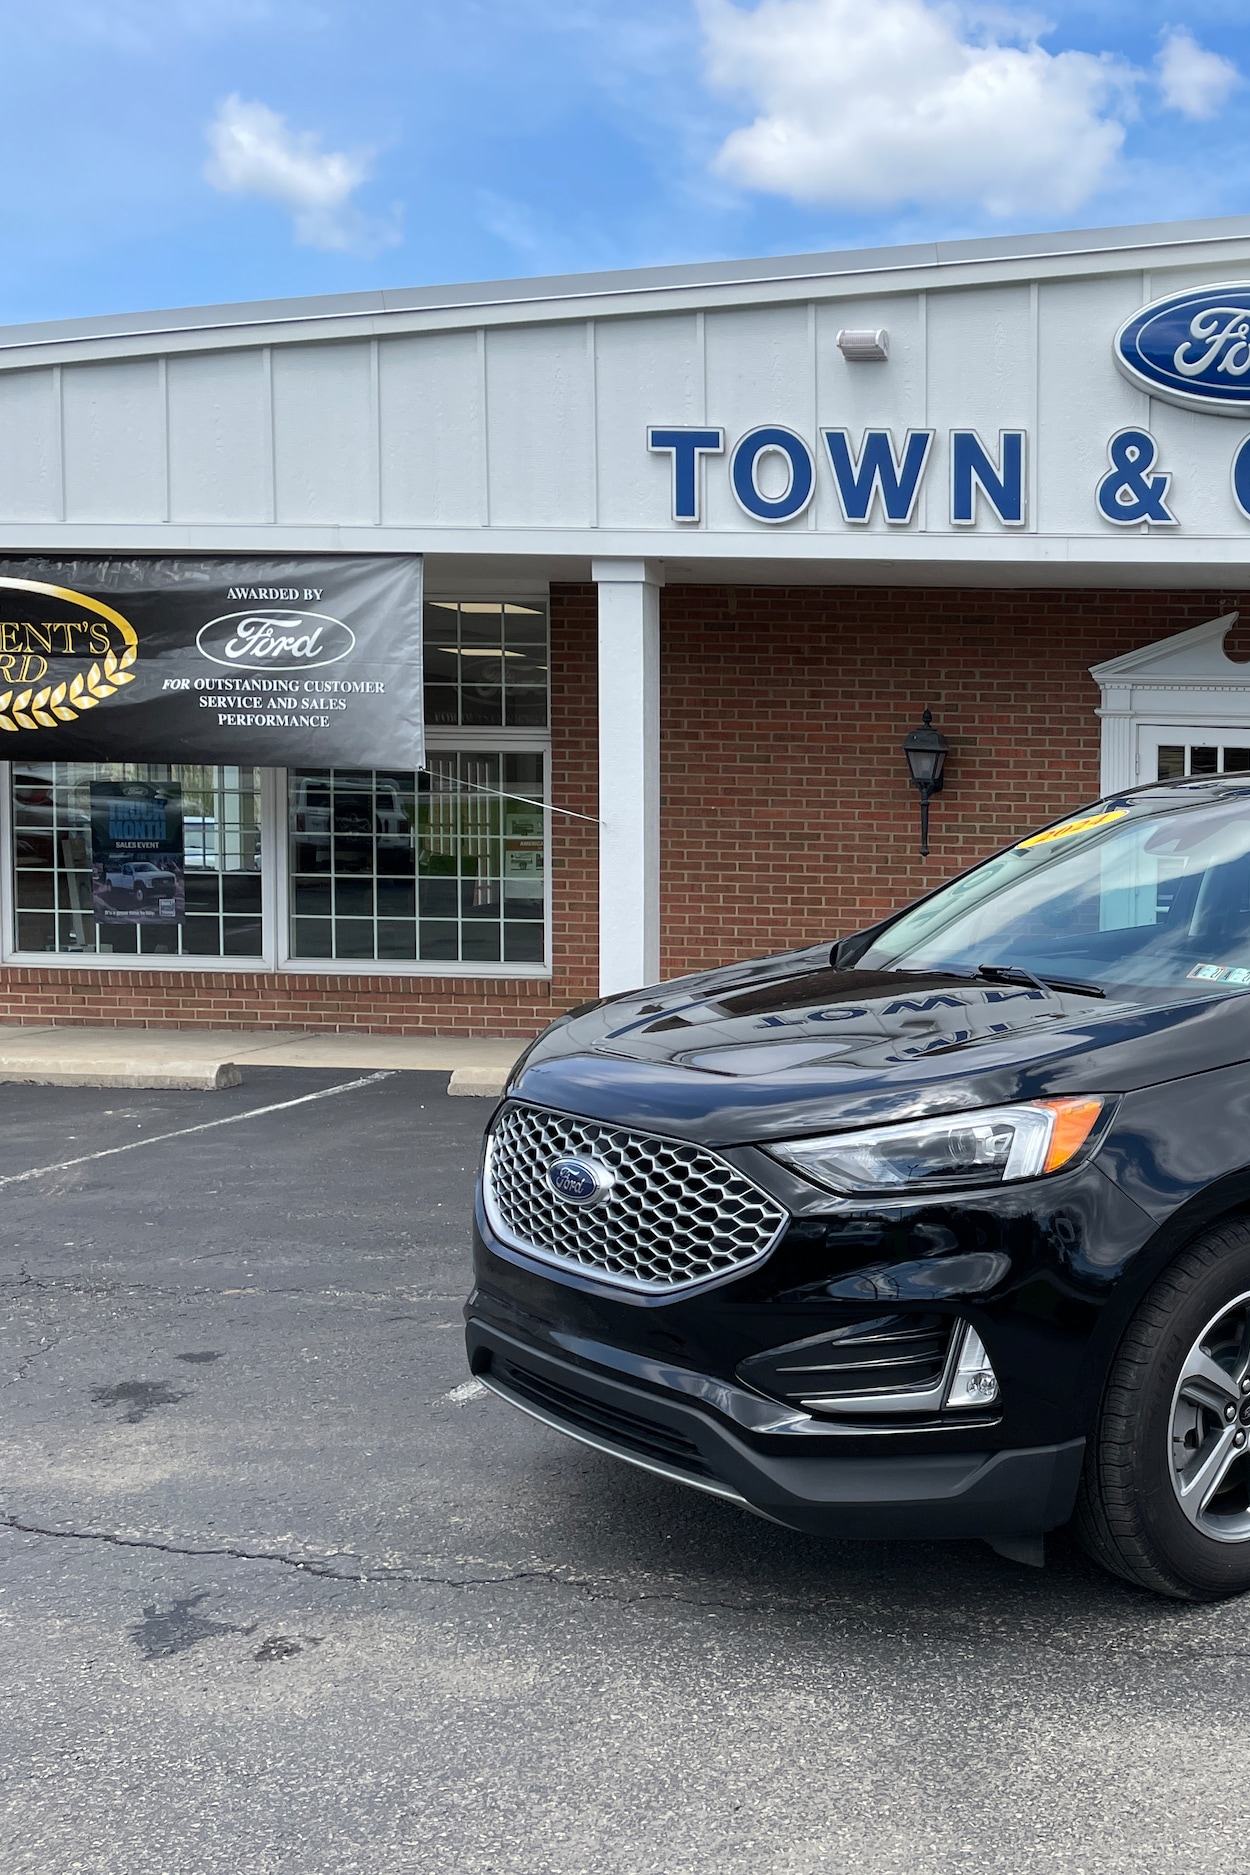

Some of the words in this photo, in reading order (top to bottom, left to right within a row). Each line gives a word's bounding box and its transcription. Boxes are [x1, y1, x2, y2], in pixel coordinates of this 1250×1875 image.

[646, 425, 1027, 526] TOWN
[1095, 426, 1180, 526] &
[227, 588, 299, 600] AWARDED
[303, 588, 324, 601] BY
[225, 617, 323, 659] Ford
[162, 679, 190, 691] FOR
[194, 678, 300, 692] OUTSTANDING
[304, 680, 385, 693] CUSTOMER
[199, 696, 262, 709] SERVICE
[267, 697, 298, 710] AND
[302, 698, 346, 710] SALES
[218, 713, 330, 727] PERFORMANCE
[107, 800, 167, 820] TRUCK
[109, 820, 166, 840] MONTH
[556, 1167, 585, 1194] Ford
